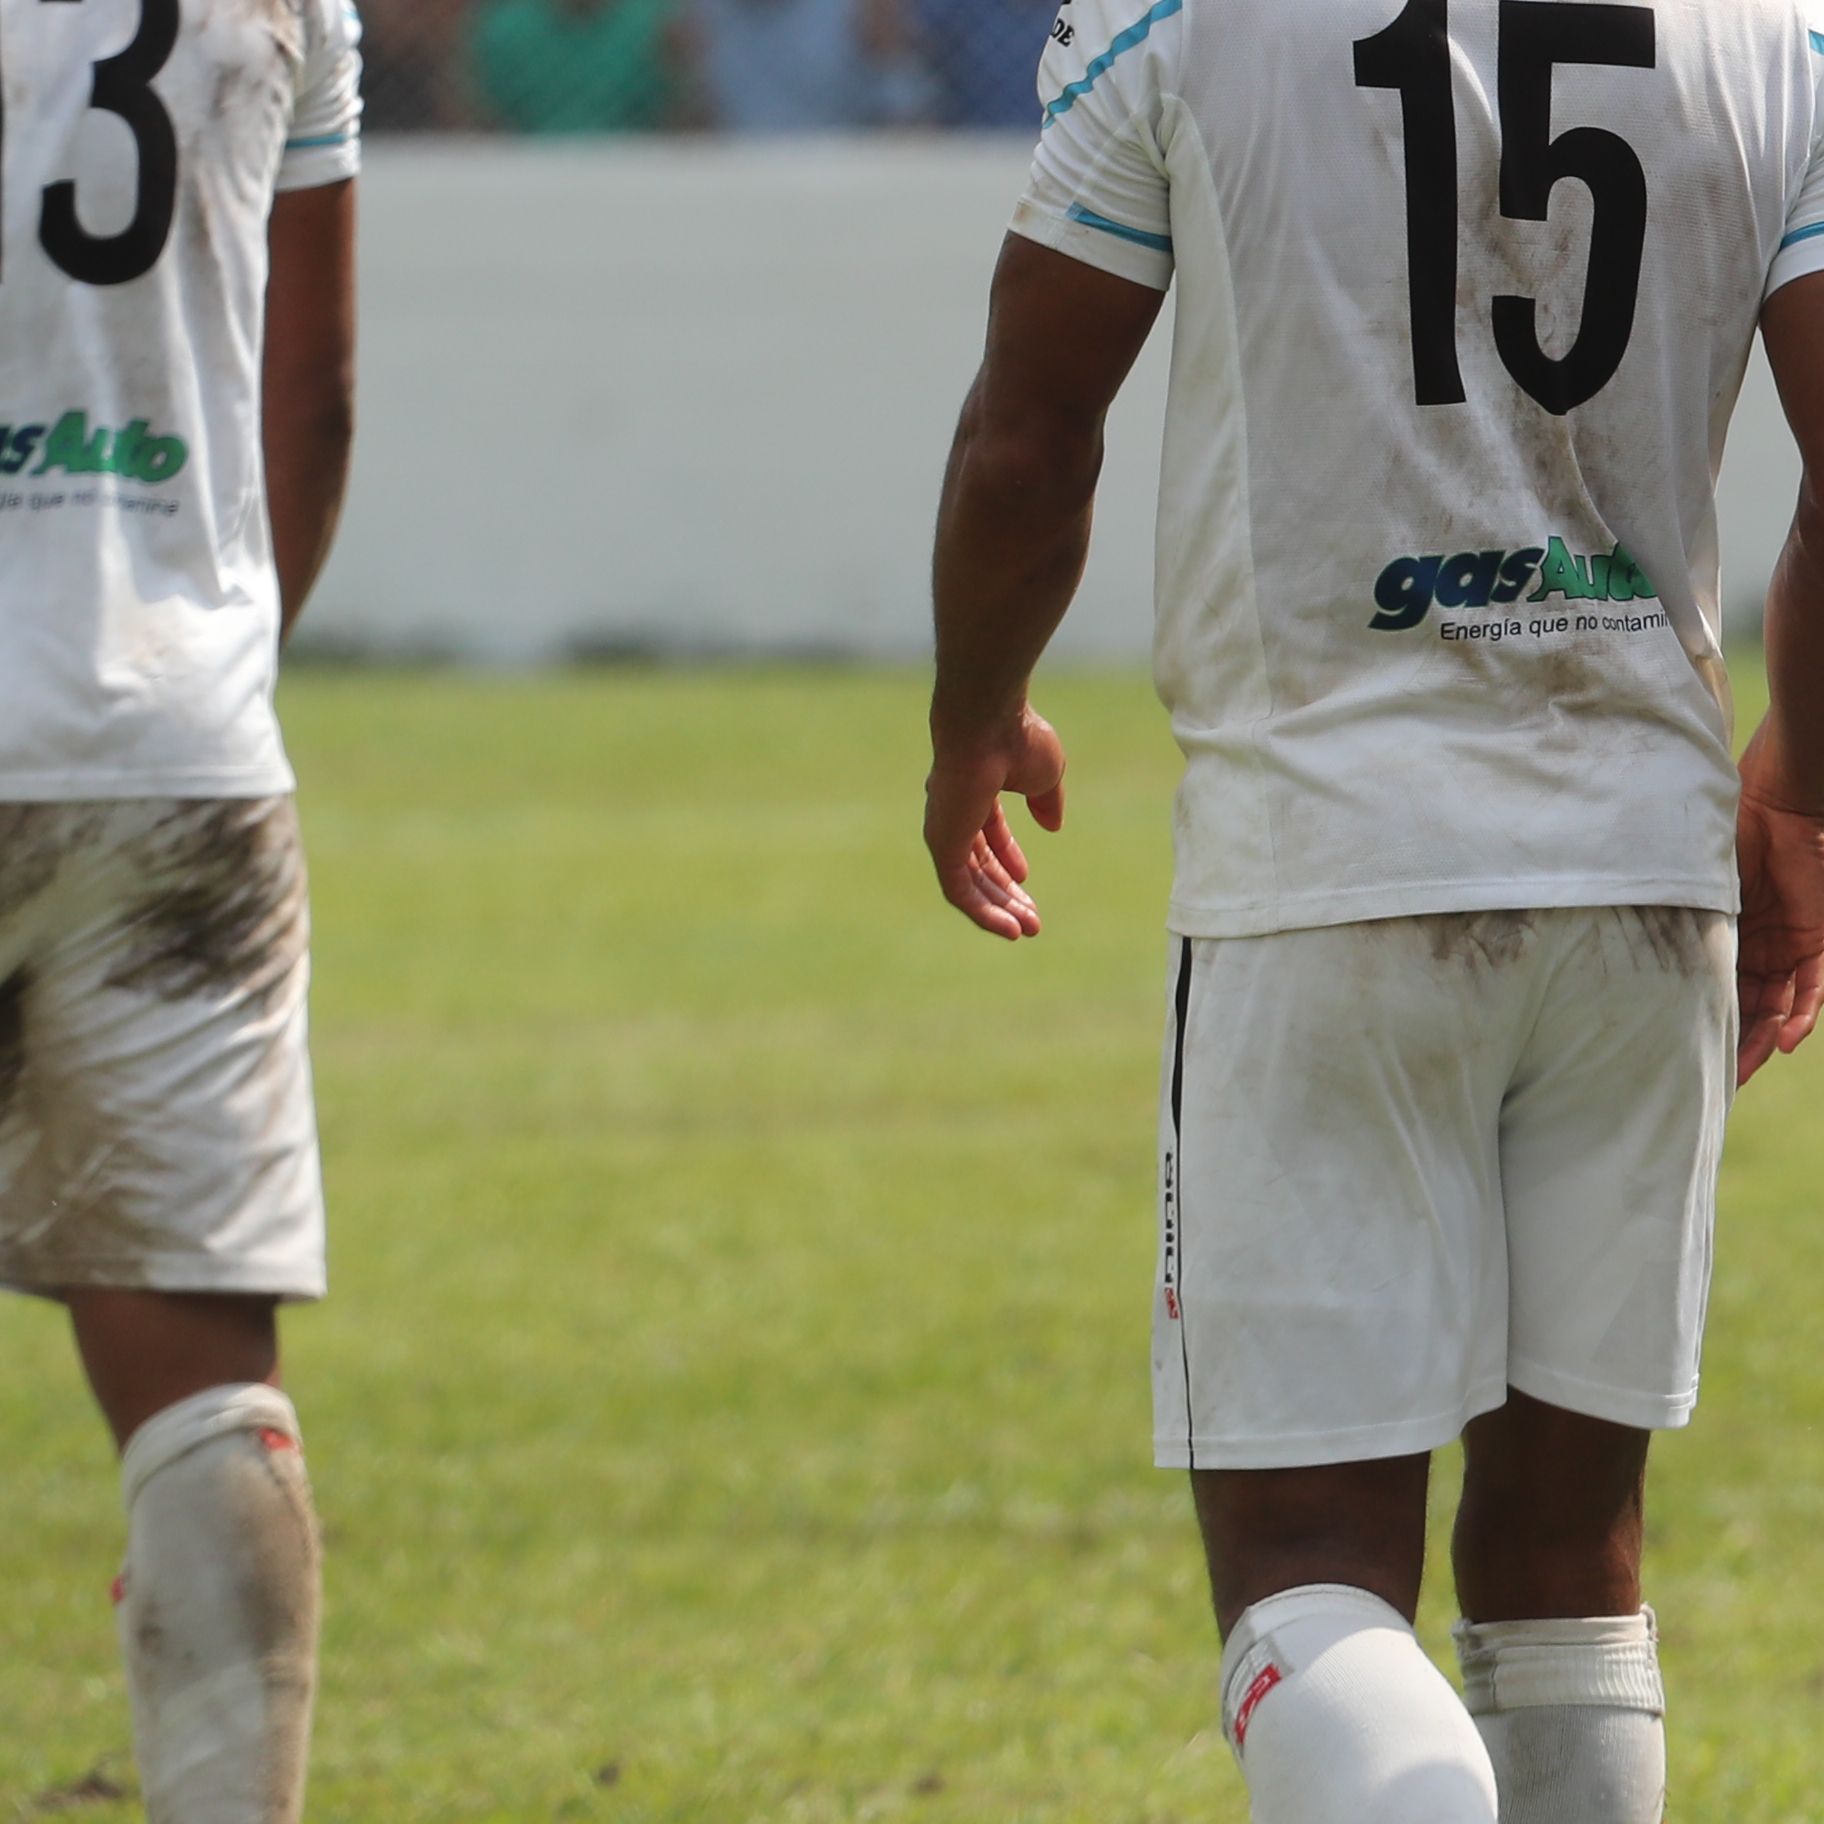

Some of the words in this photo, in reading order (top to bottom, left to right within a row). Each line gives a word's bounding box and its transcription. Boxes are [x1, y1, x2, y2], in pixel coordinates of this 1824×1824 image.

[0, 411, 189, 483] sAuto
[1440, 618, 1522, 642] Energía
[1528, 615, 1569, 641] que
[1575, 613, 1598, 632] no
[1602, 608, 1670, 634] contami
